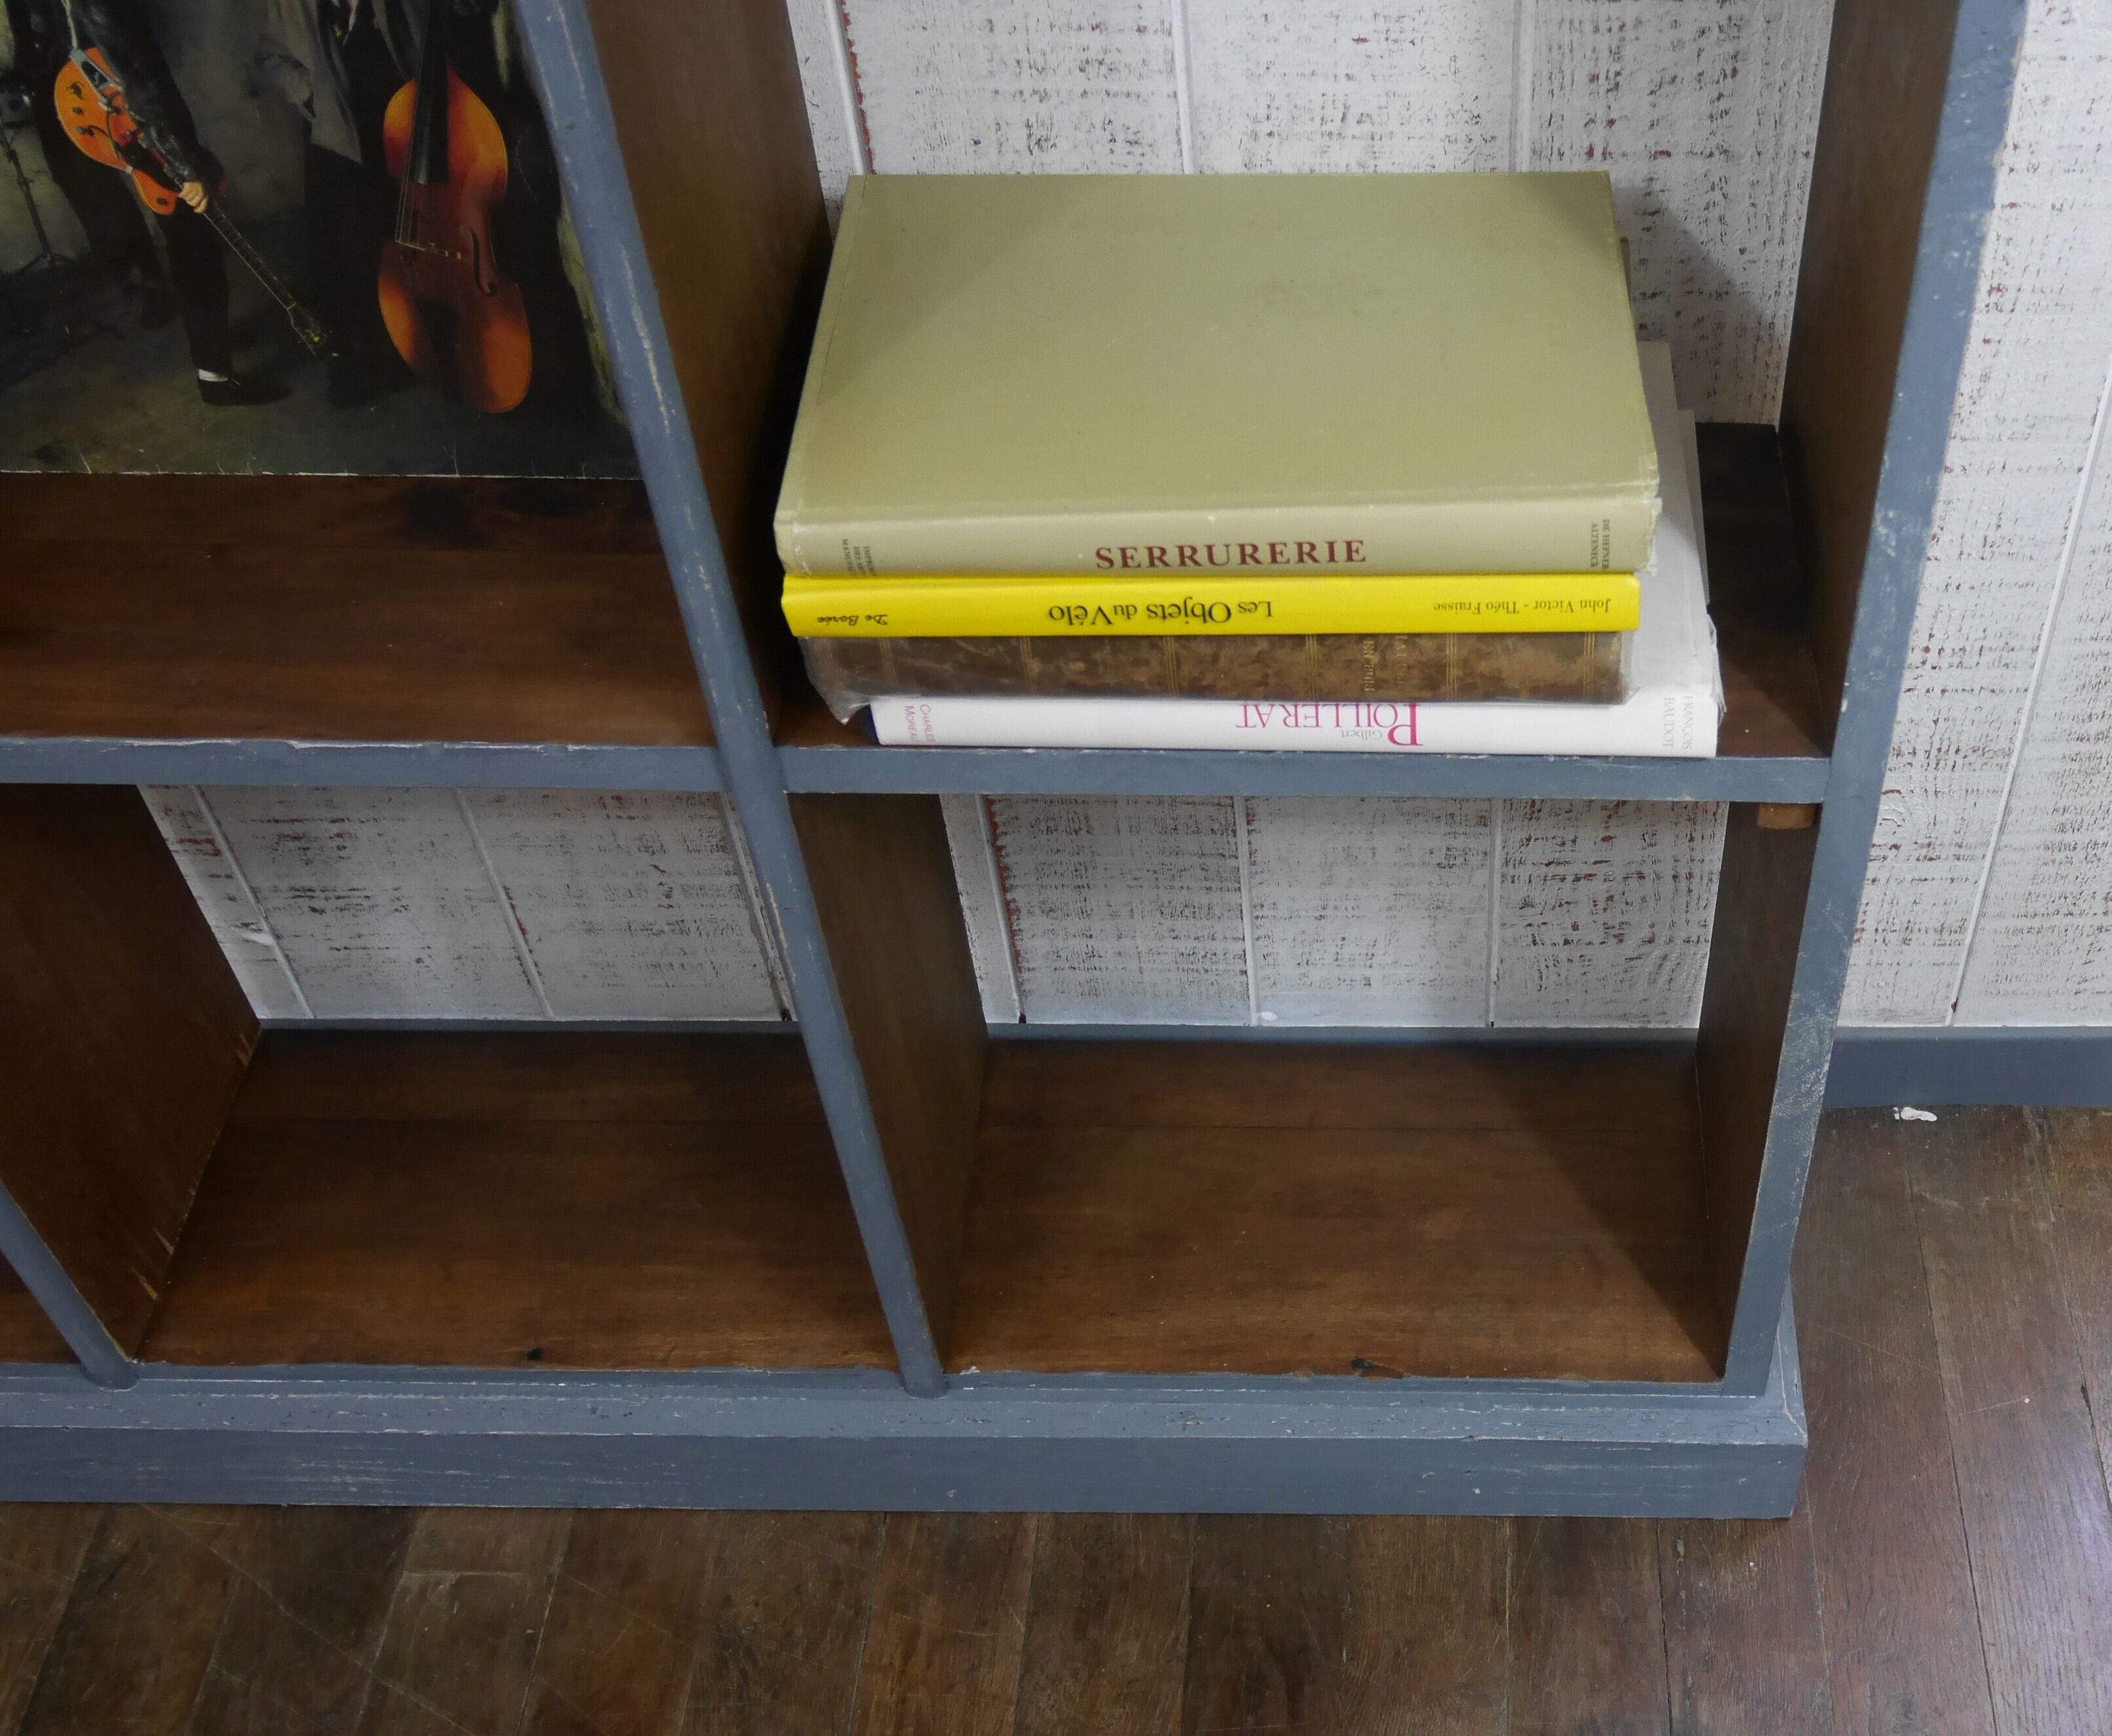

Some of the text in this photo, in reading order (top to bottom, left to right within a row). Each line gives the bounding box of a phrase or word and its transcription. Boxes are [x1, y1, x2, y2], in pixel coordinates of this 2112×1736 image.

[1095, 539, 1367, 570] SERRURERIE
[817, 614, 889, 626] De Borée
[1048, 596, 1273, 626] Les Objets du Vélo
[1433, 601, 1481, 615] Fraisse
[1485, 600, 1520, 614] Théo
[1532, 599, 1574, 614] Victor
[1579, 598, 1611, 613] John
[904, 705, 919, 742] MOREAU
[919, 704, 936, 743] CHARLES
[1235, 702, 1424, 746] POILLERAT
[1341, 729, 1383, 741] Gilbert
[1663, 697, 1676, 749] BAUDOT
[1681, 696, 1694, 750] FRANÇOIS
